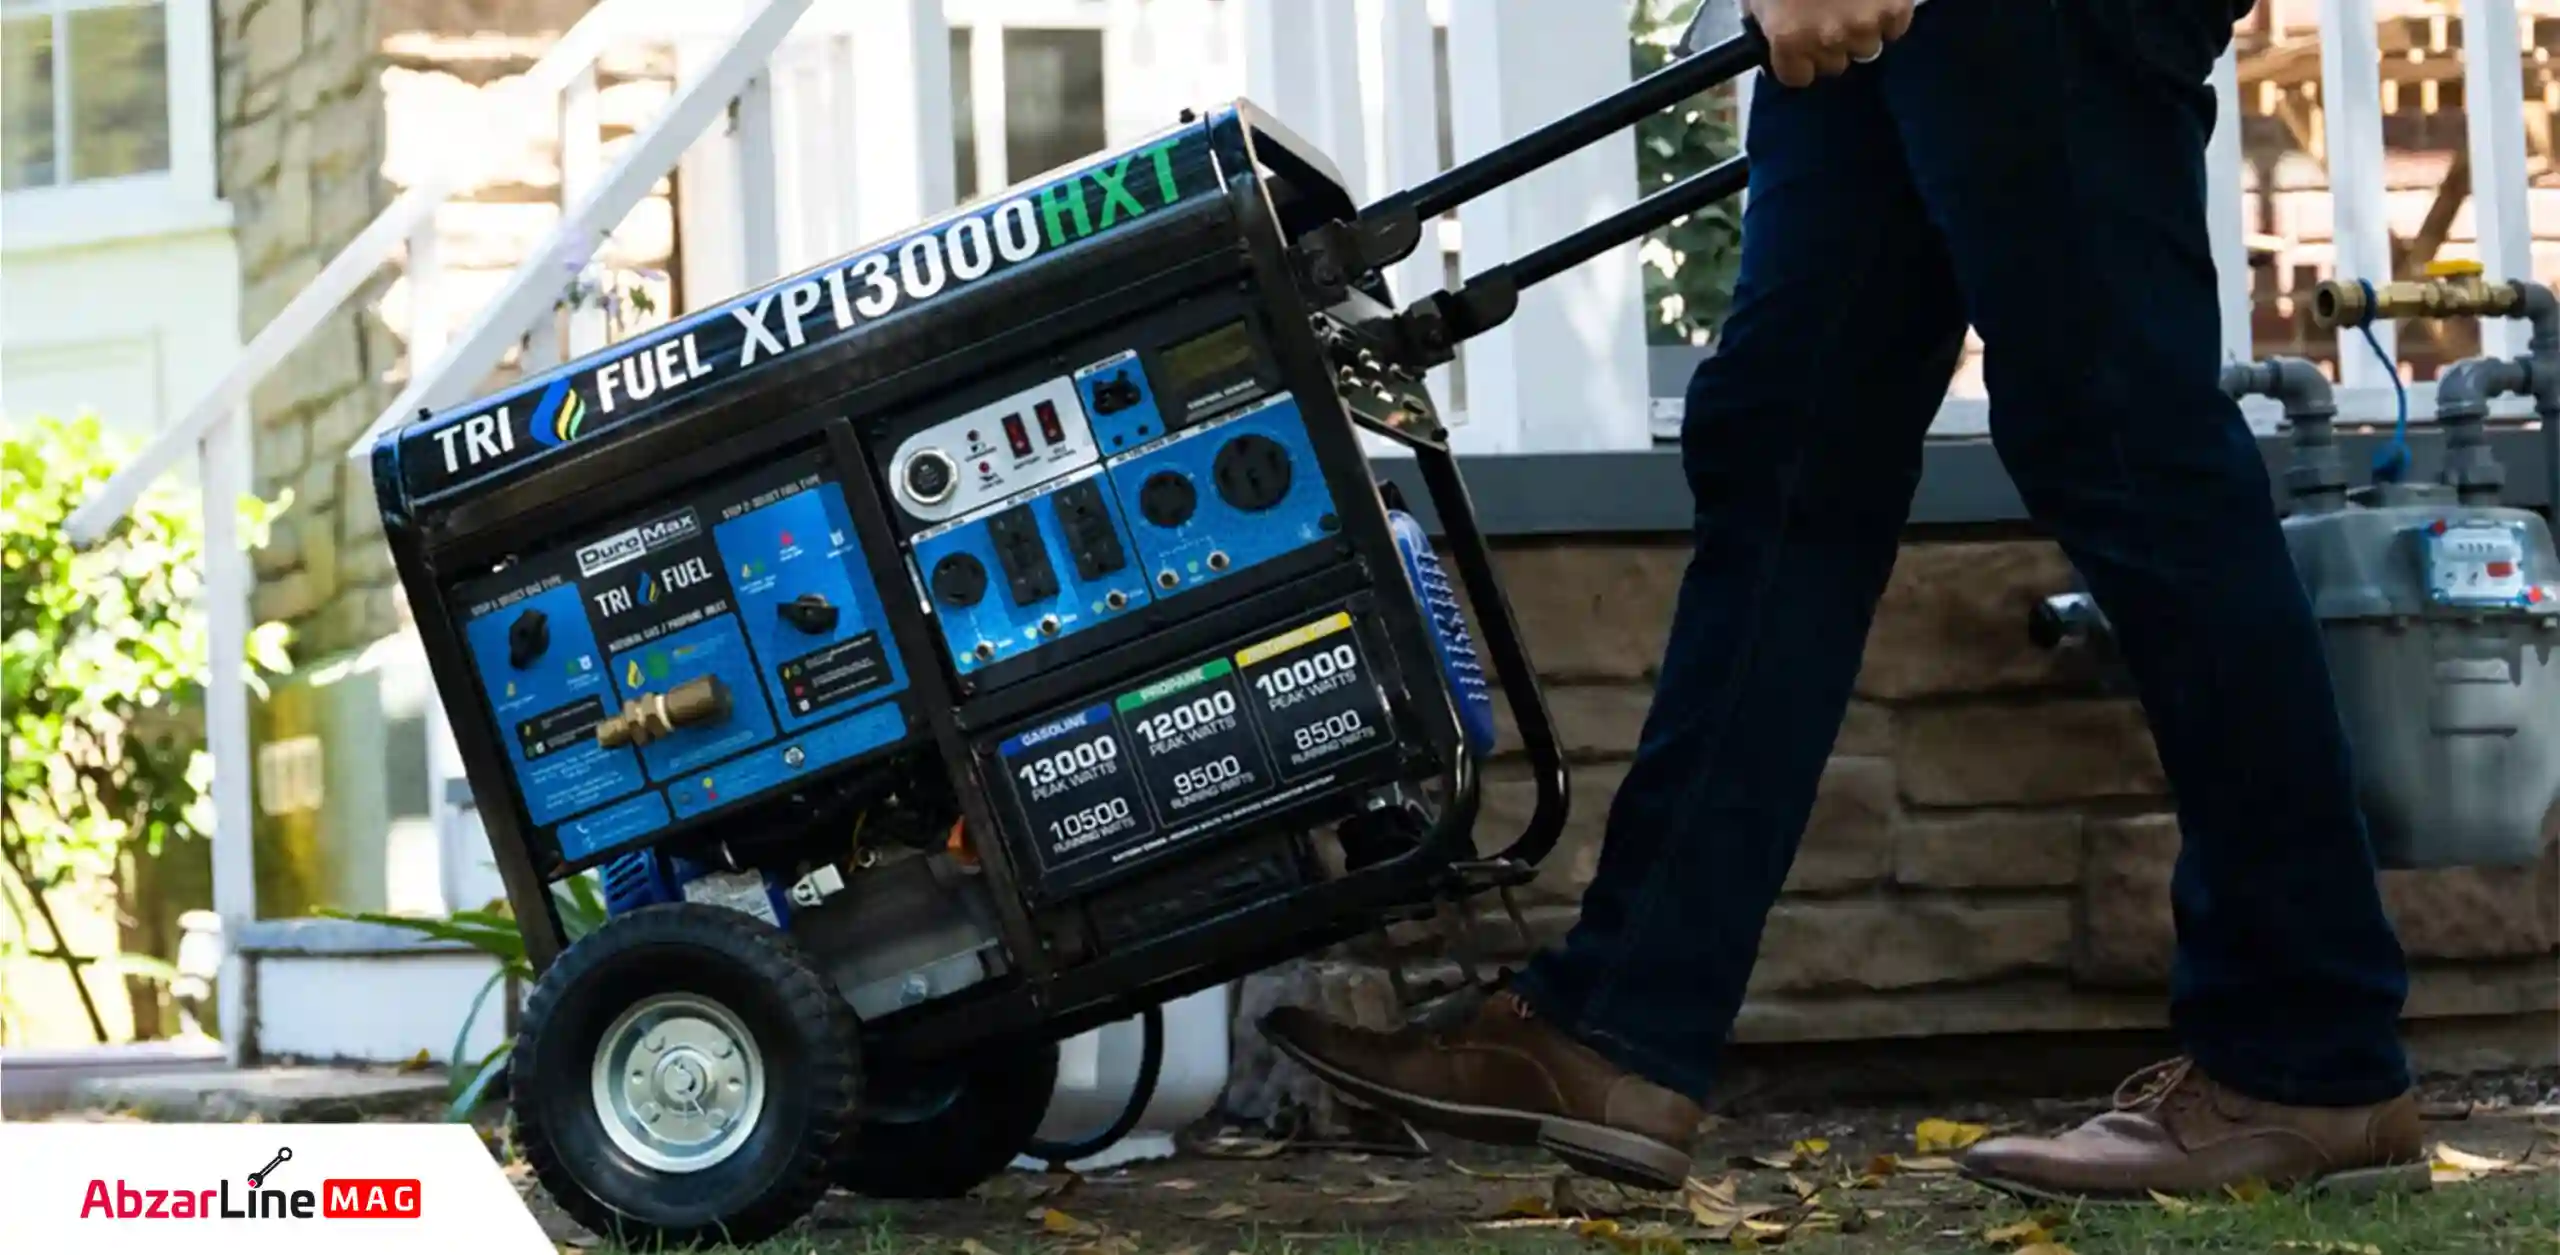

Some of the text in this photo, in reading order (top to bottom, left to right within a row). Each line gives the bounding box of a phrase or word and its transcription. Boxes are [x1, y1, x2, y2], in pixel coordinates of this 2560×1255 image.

[433, 139, 1181, 474] TRI FUEL XP13000HXT
[594, 585, 633, 618] TRI
[661, 556, 712, 593] FUEL
[1255, 644, 1356, 697] 10000
[1268, 670, 1357, 711] PEAK WATTS
[1021, 712, 1087, 746] GASOLINE
[1136, 690, 1236, 743] 12000
[1149, 715, 1236, 756] PEAK WATTS
[1294, 709, 1361, 750] 8500
[1019, 735, 1117, 787] 13000
[1031, 760, 1117, 801] PEAK WATTS
[1173, 755, 1240, 795] 9500
[1050, 797, 1129, 840] 10500
